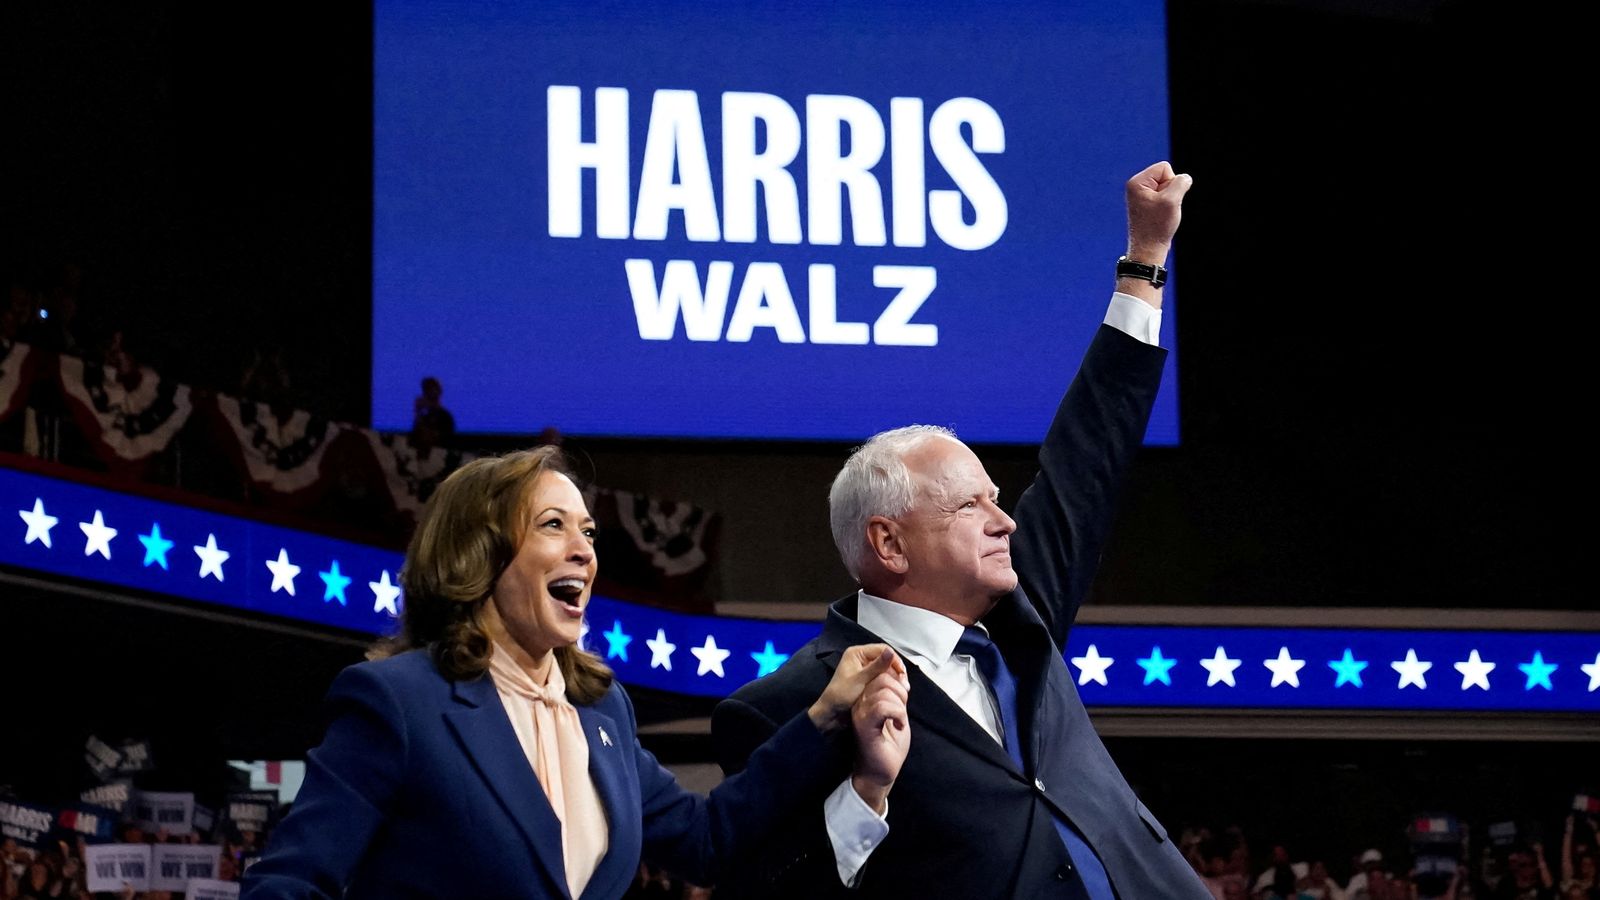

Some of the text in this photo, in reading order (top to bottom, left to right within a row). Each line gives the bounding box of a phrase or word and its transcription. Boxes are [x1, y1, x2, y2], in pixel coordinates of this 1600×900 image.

[546, 85, 1008, 251] HARRIS
[624, 257, 938, 347] WALZ
[95, 861, 145, 879] WE WIN
[160, 861, 213, 879] WE WIN
